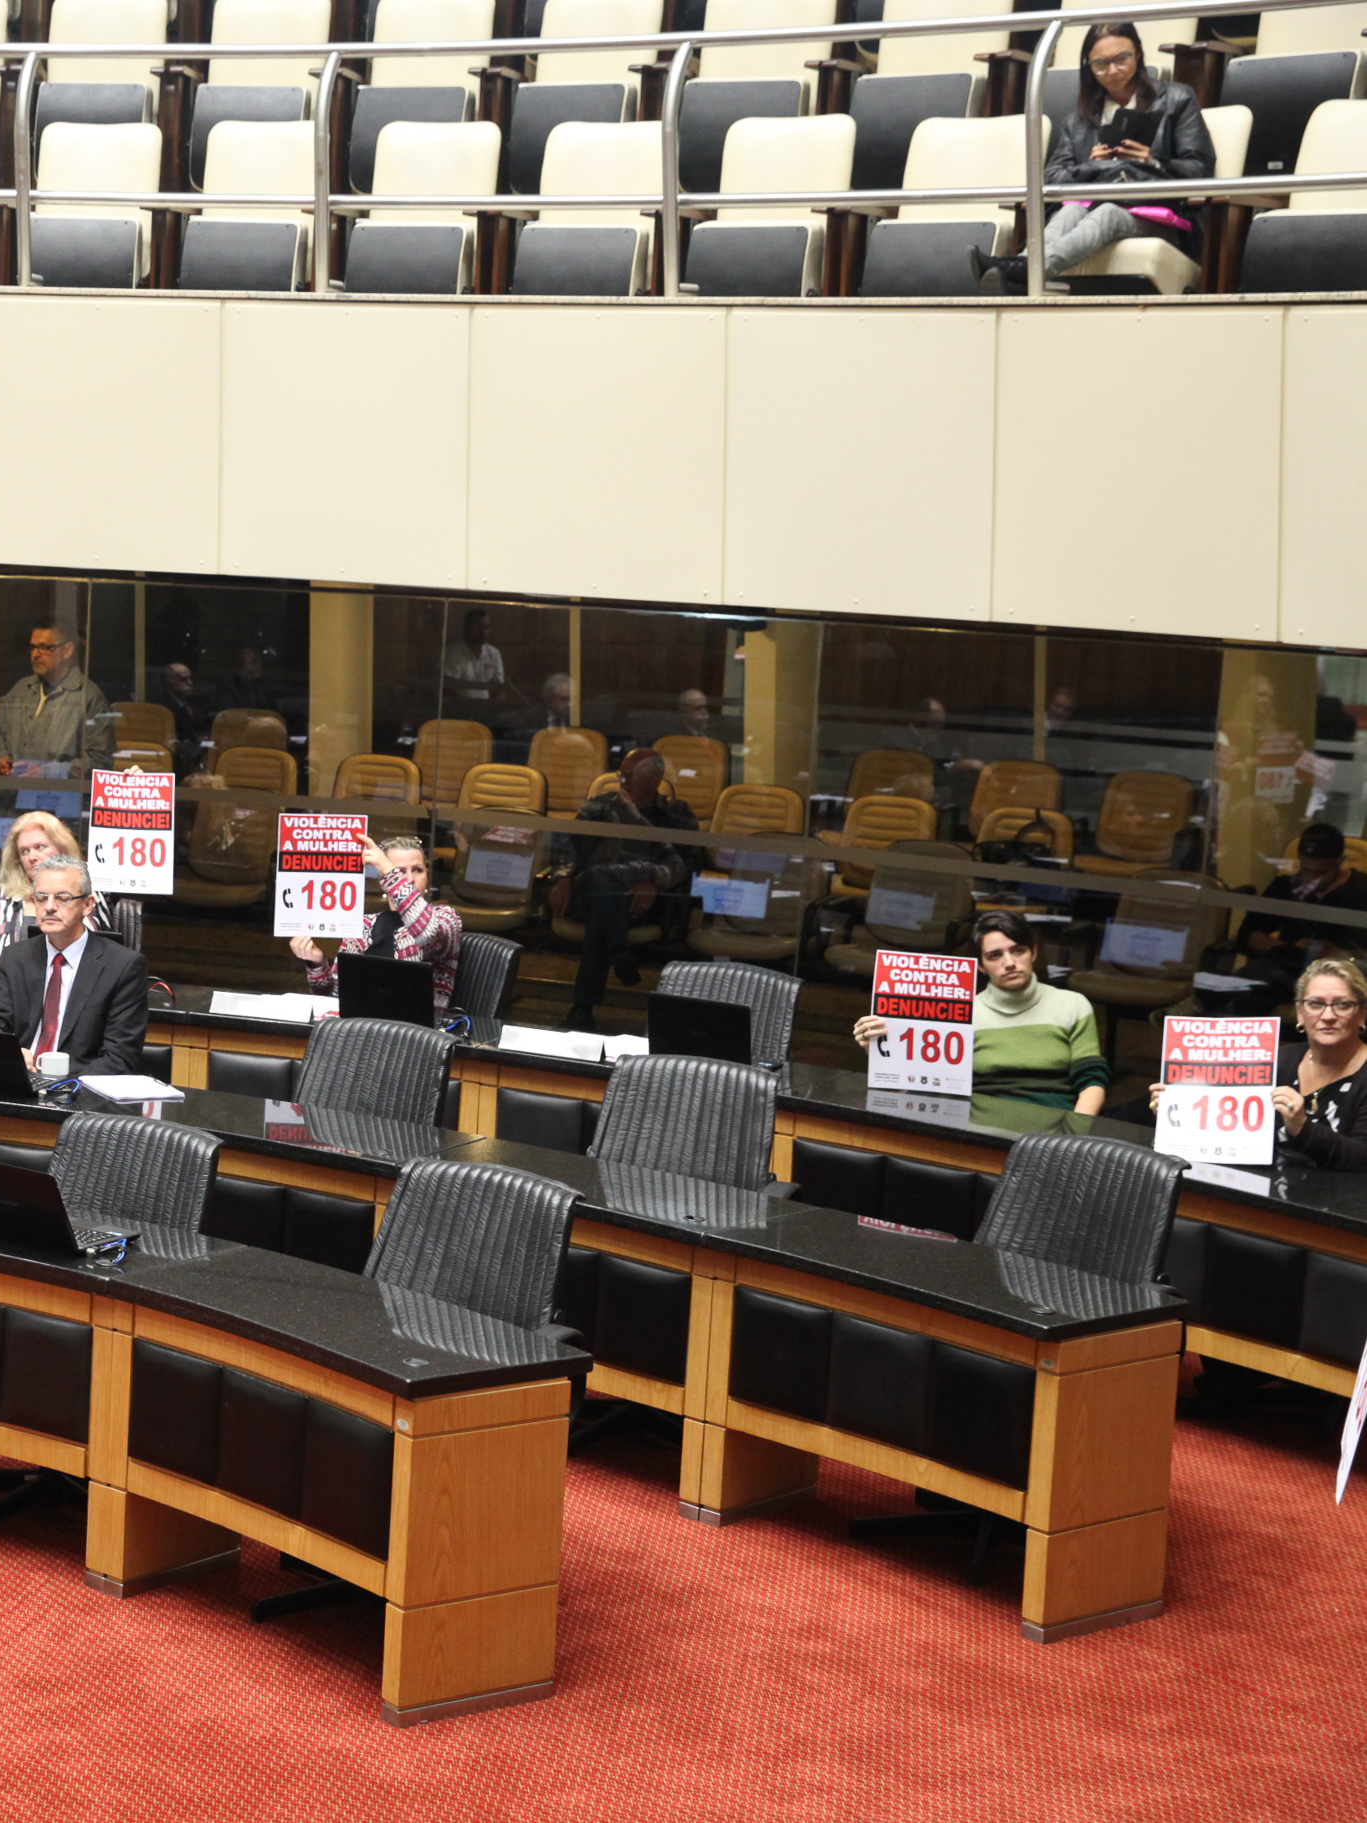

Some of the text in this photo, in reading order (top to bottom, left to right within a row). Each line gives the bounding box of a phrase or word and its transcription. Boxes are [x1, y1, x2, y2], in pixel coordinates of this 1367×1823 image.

[104, 786, 160, 798] CONTRA
[95, 796, 170, 810] A MULHER:
[94, 810, 171, 829] DENUNCIE!
[284, 815, 362, 829] VIOLÊNCIA
[292, 829, 352, 840] CONTRA
[112, 836, 166, 868] 180
[283, 840, 362, 852] A MULHER:
[282, 854, 362, 871] DENUNCIE!
[301, 879, 357, 911] 180
[882, 954, 971, 973] VIOLÊNCIA
[889, 969, 960, 985] CONTRA
[878, 981, 971, 1000] A MULHER:
[876, 997, 970, 1021] DENUNCIE!
[1171, 1020, 1273, 1034] VIOLÊNCIA
[899, 1027, 964, 1065] 180
[1182, 1035, 1260, 1048] CONTRA
[1169, 1049, 1272, 1061] A MULHER:
[1167, 1064, 1271, 1085] DENUNCIE!
[1192, 1095, 1265, 1132] 180
